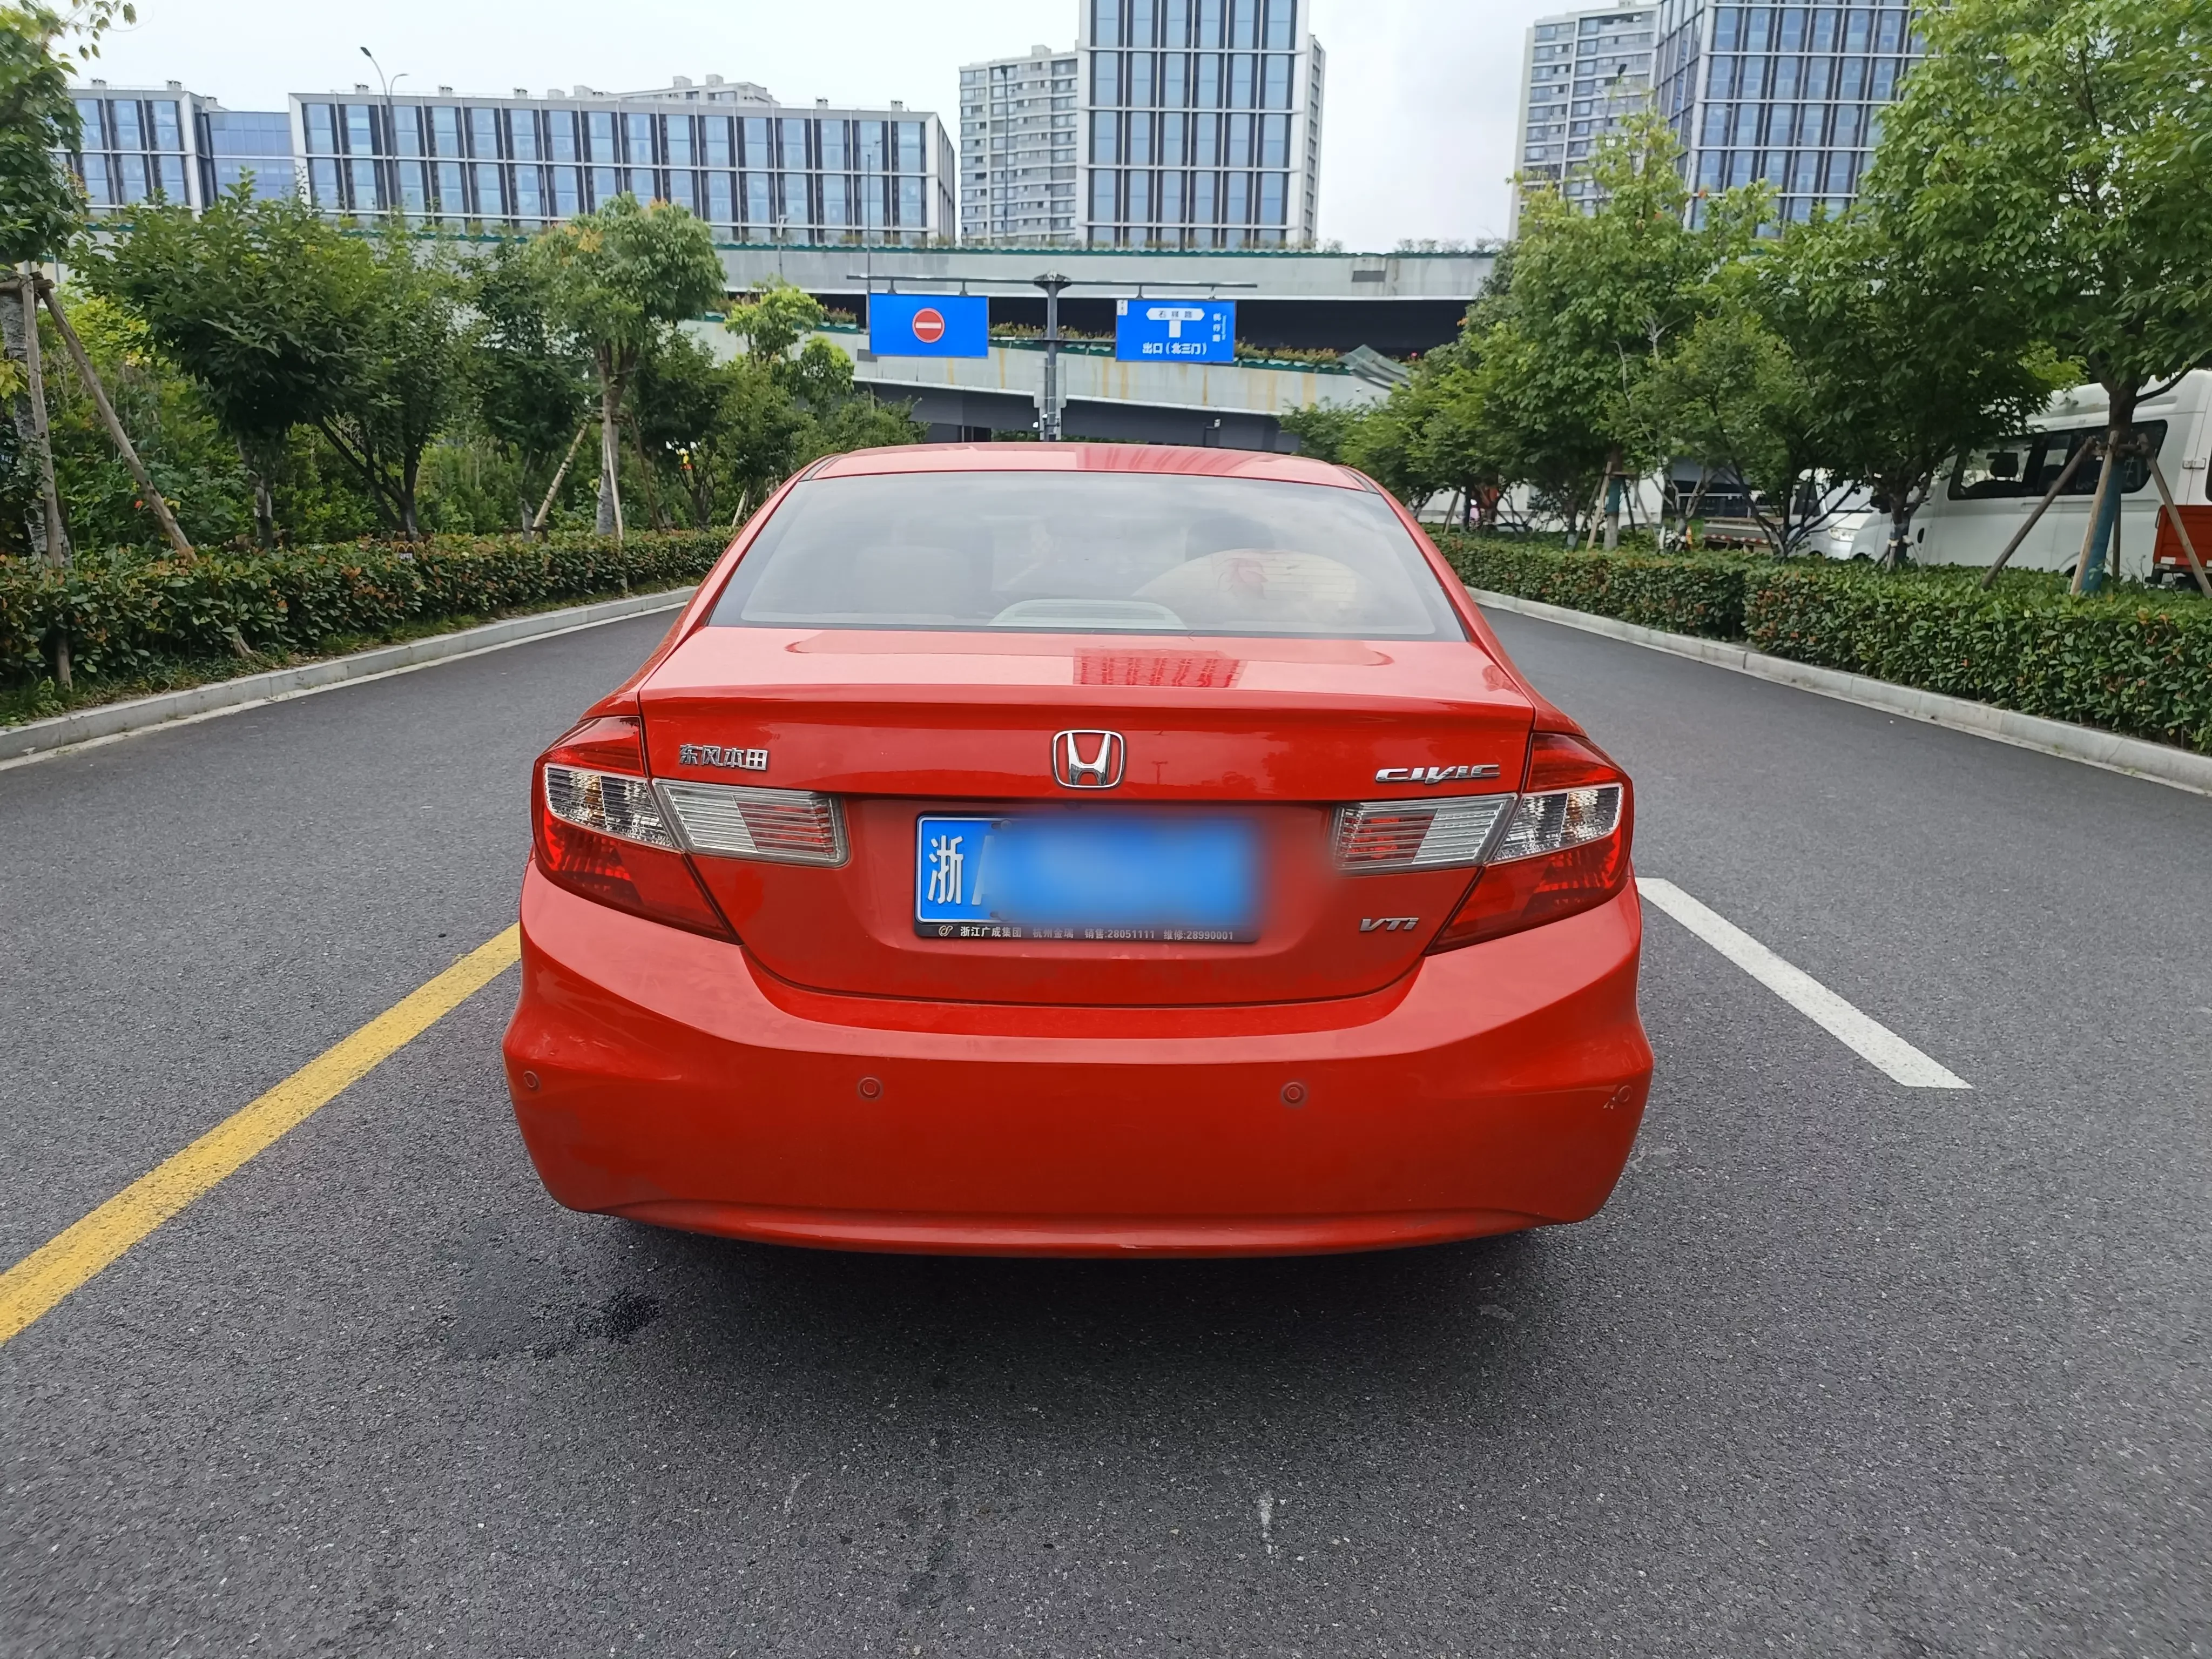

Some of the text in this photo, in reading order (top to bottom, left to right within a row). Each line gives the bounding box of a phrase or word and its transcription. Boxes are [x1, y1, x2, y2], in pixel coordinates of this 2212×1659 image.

[679, 744, 768, 771] 东风本田
[1375, 764, 1500, 784] CIVIC
[960, 926, 1233, 940] 浙江广成集团 杭州金瑞 销售:28051111 维修:28990001
